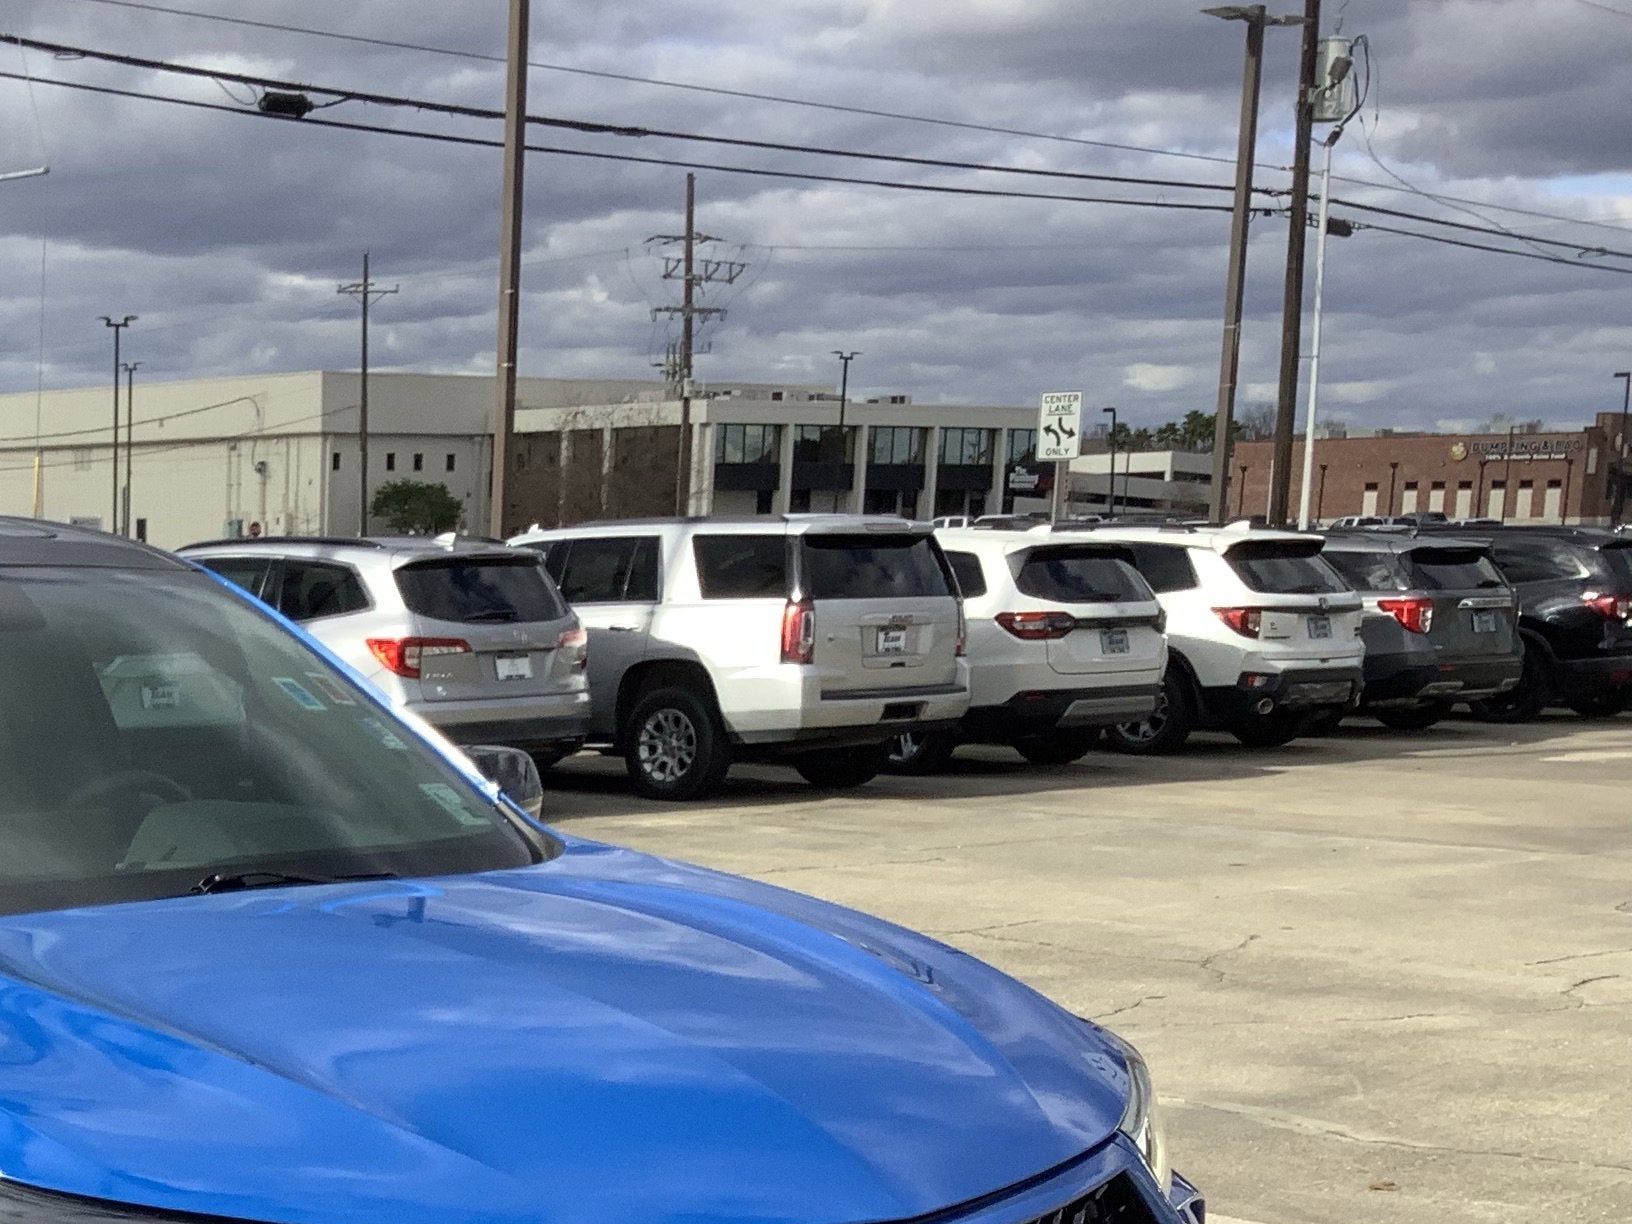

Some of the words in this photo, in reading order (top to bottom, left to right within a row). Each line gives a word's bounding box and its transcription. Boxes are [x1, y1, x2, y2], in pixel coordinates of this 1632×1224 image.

[1044, 394, 1079, 404] CENTER
[1048, 404, 1073, 413] LANE
[1045, 447, 1070, 457] ONLY
[1472, 441, 1537, 453] DUMPING
